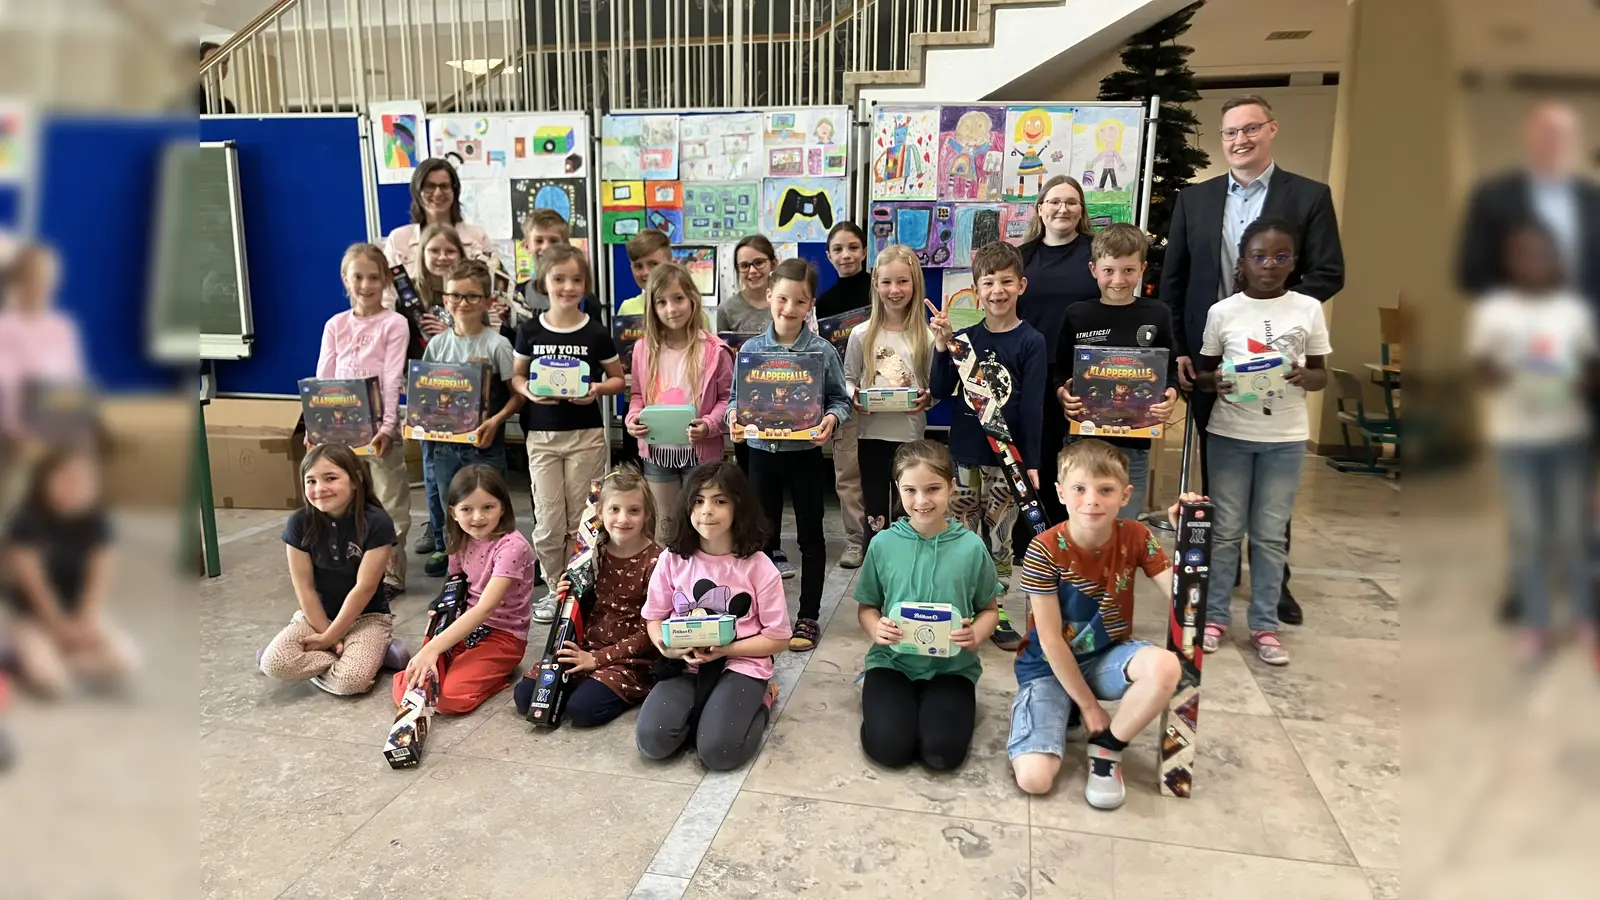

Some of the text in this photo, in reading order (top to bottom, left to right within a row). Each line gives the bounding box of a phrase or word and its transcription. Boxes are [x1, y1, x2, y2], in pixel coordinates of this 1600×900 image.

[533, 345, 588, 356] NEW YORK
[751, 369, 809, 381] KLAPPERFALLE
[1090, 365, 1152, 378] KLAPPERFALLE
[1189, 528, 1206, 544] XL
[913, 612, 932, 620] Pelikan
